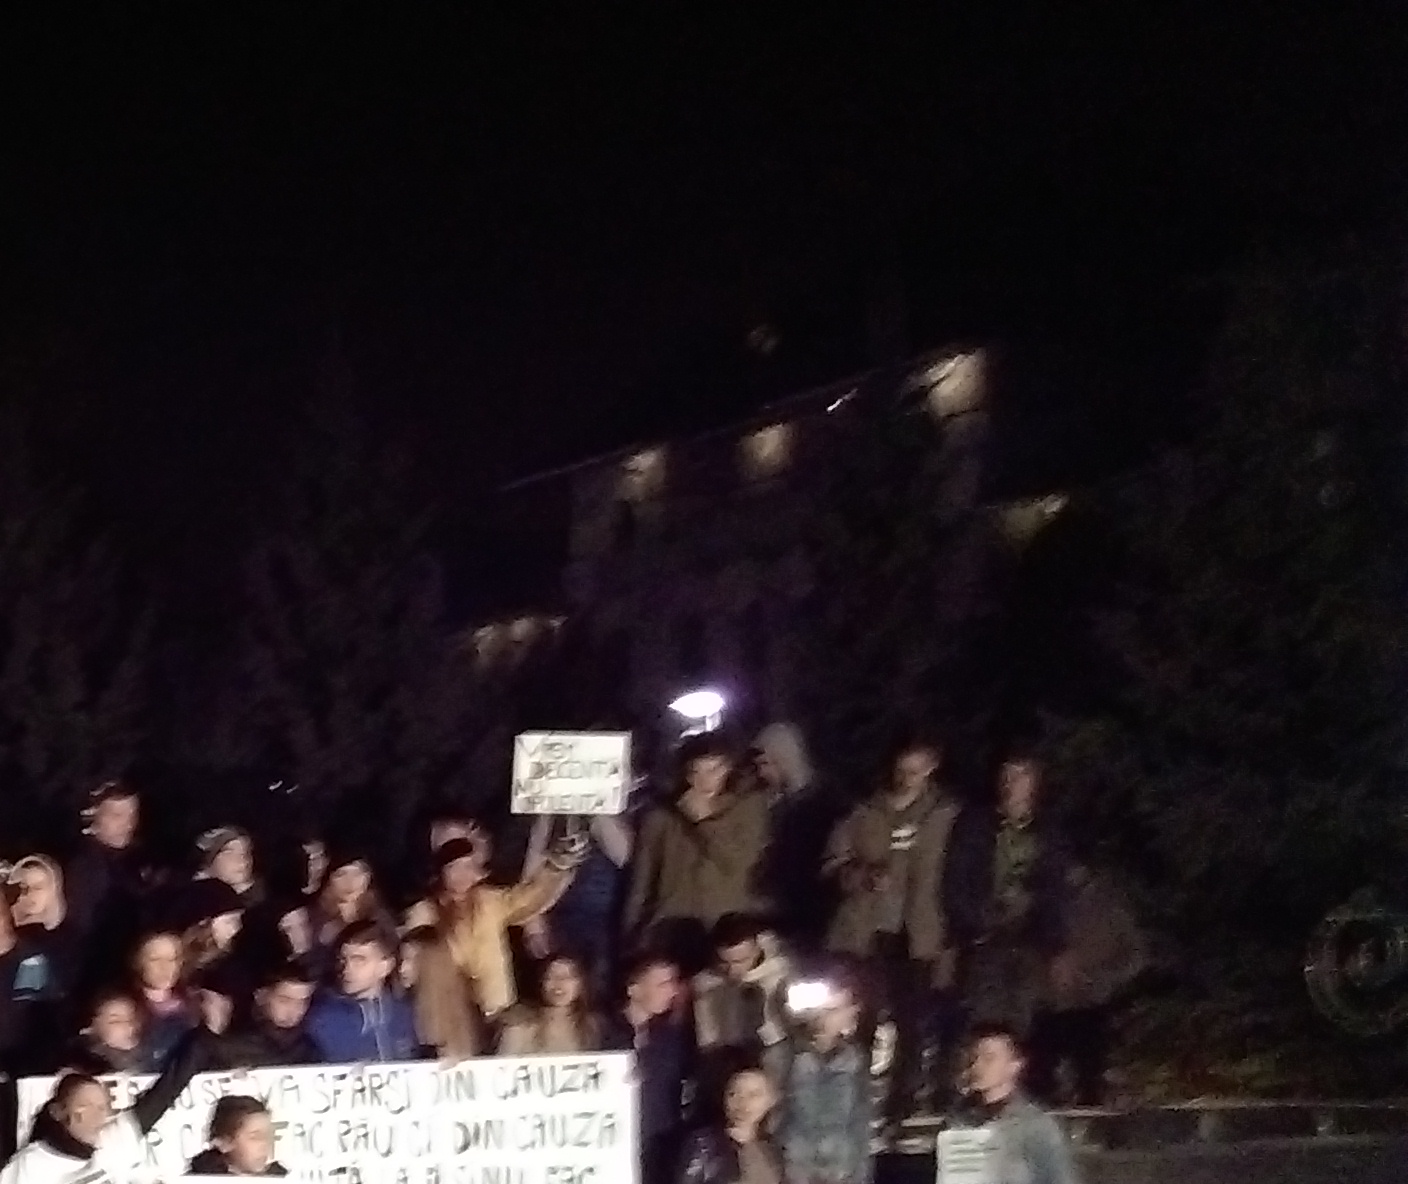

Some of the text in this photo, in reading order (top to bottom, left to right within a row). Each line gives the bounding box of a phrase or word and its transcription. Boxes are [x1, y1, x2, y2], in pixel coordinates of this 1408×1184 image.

[432, 1068, 477, 1105] DIN
[493, 1061, 605, 1101] CAUZA
[453, 1119, 504, 1155] DIN
[517, 1111, 619, 1151] CAUZA
